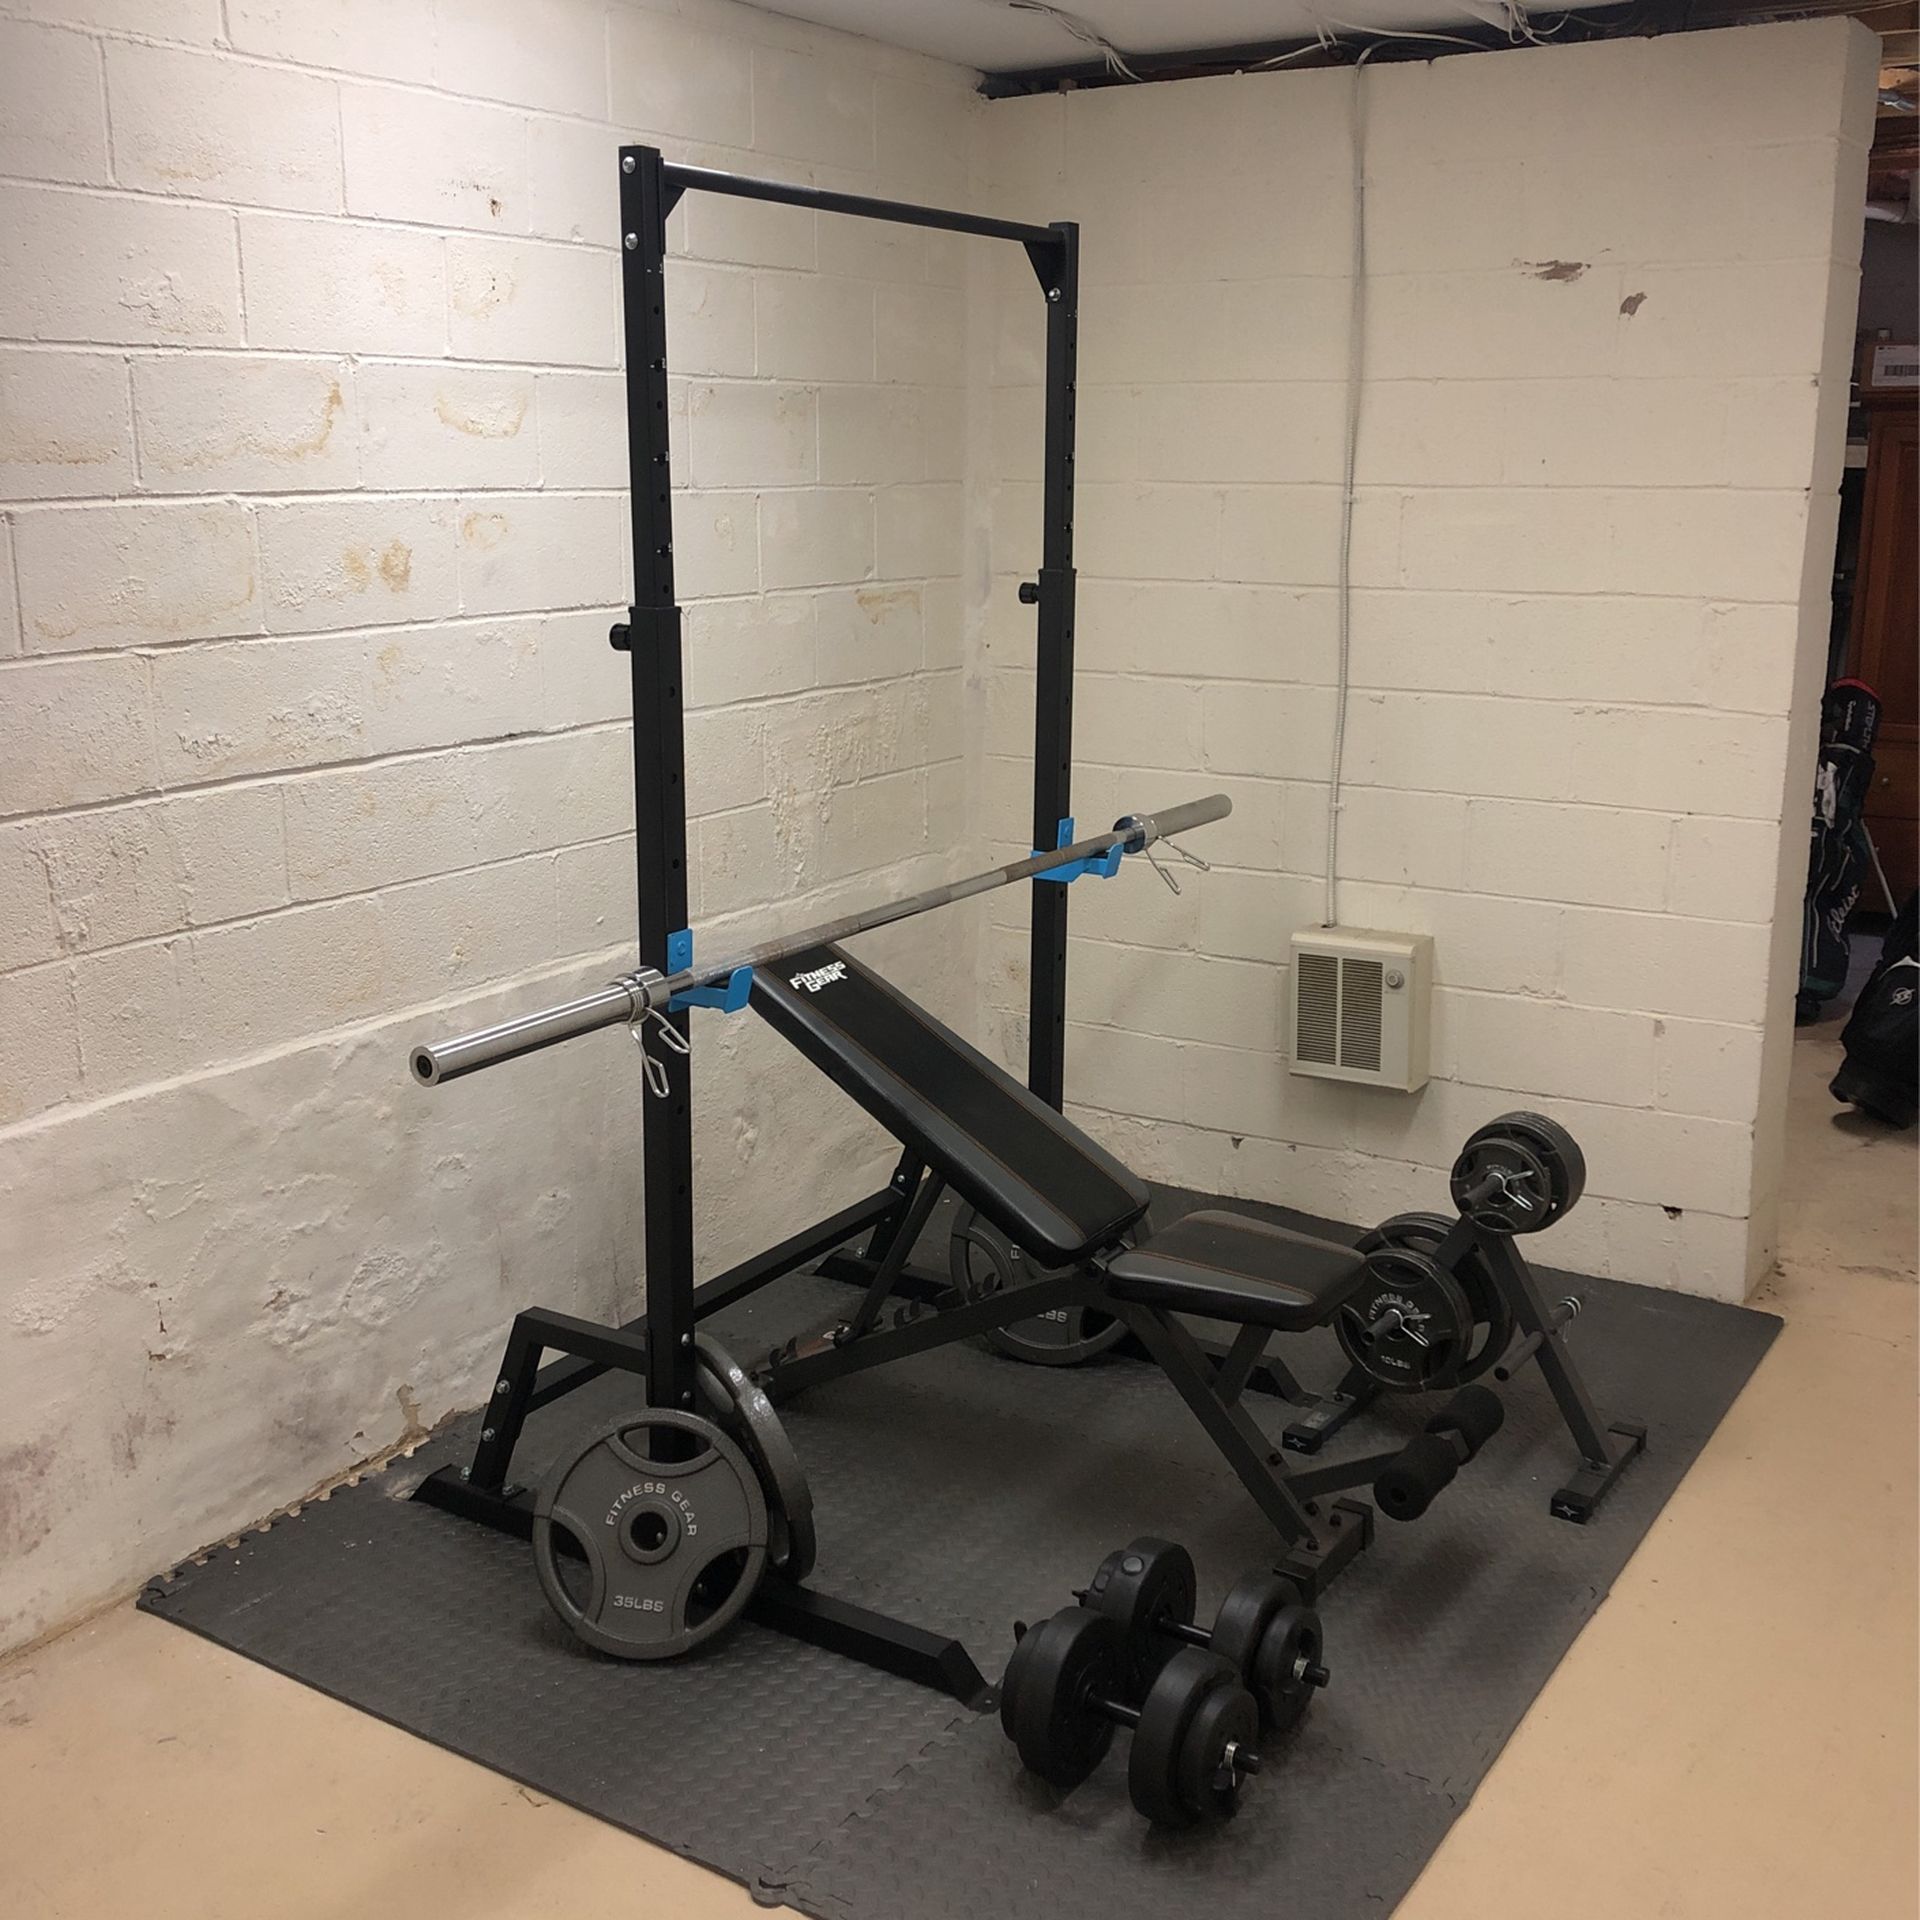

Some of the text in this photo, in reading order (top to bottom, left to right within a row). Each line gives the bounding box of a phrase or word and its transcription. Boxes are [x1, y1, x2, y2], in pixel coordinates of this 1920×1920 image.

[789, 960, 847, 990] FITNESS
[805, 970, 848, 993] GEAR
[605, 1482, 697, 1537] FITNESS GEAR
[613, 1595, 664, 1613] 35LBS
